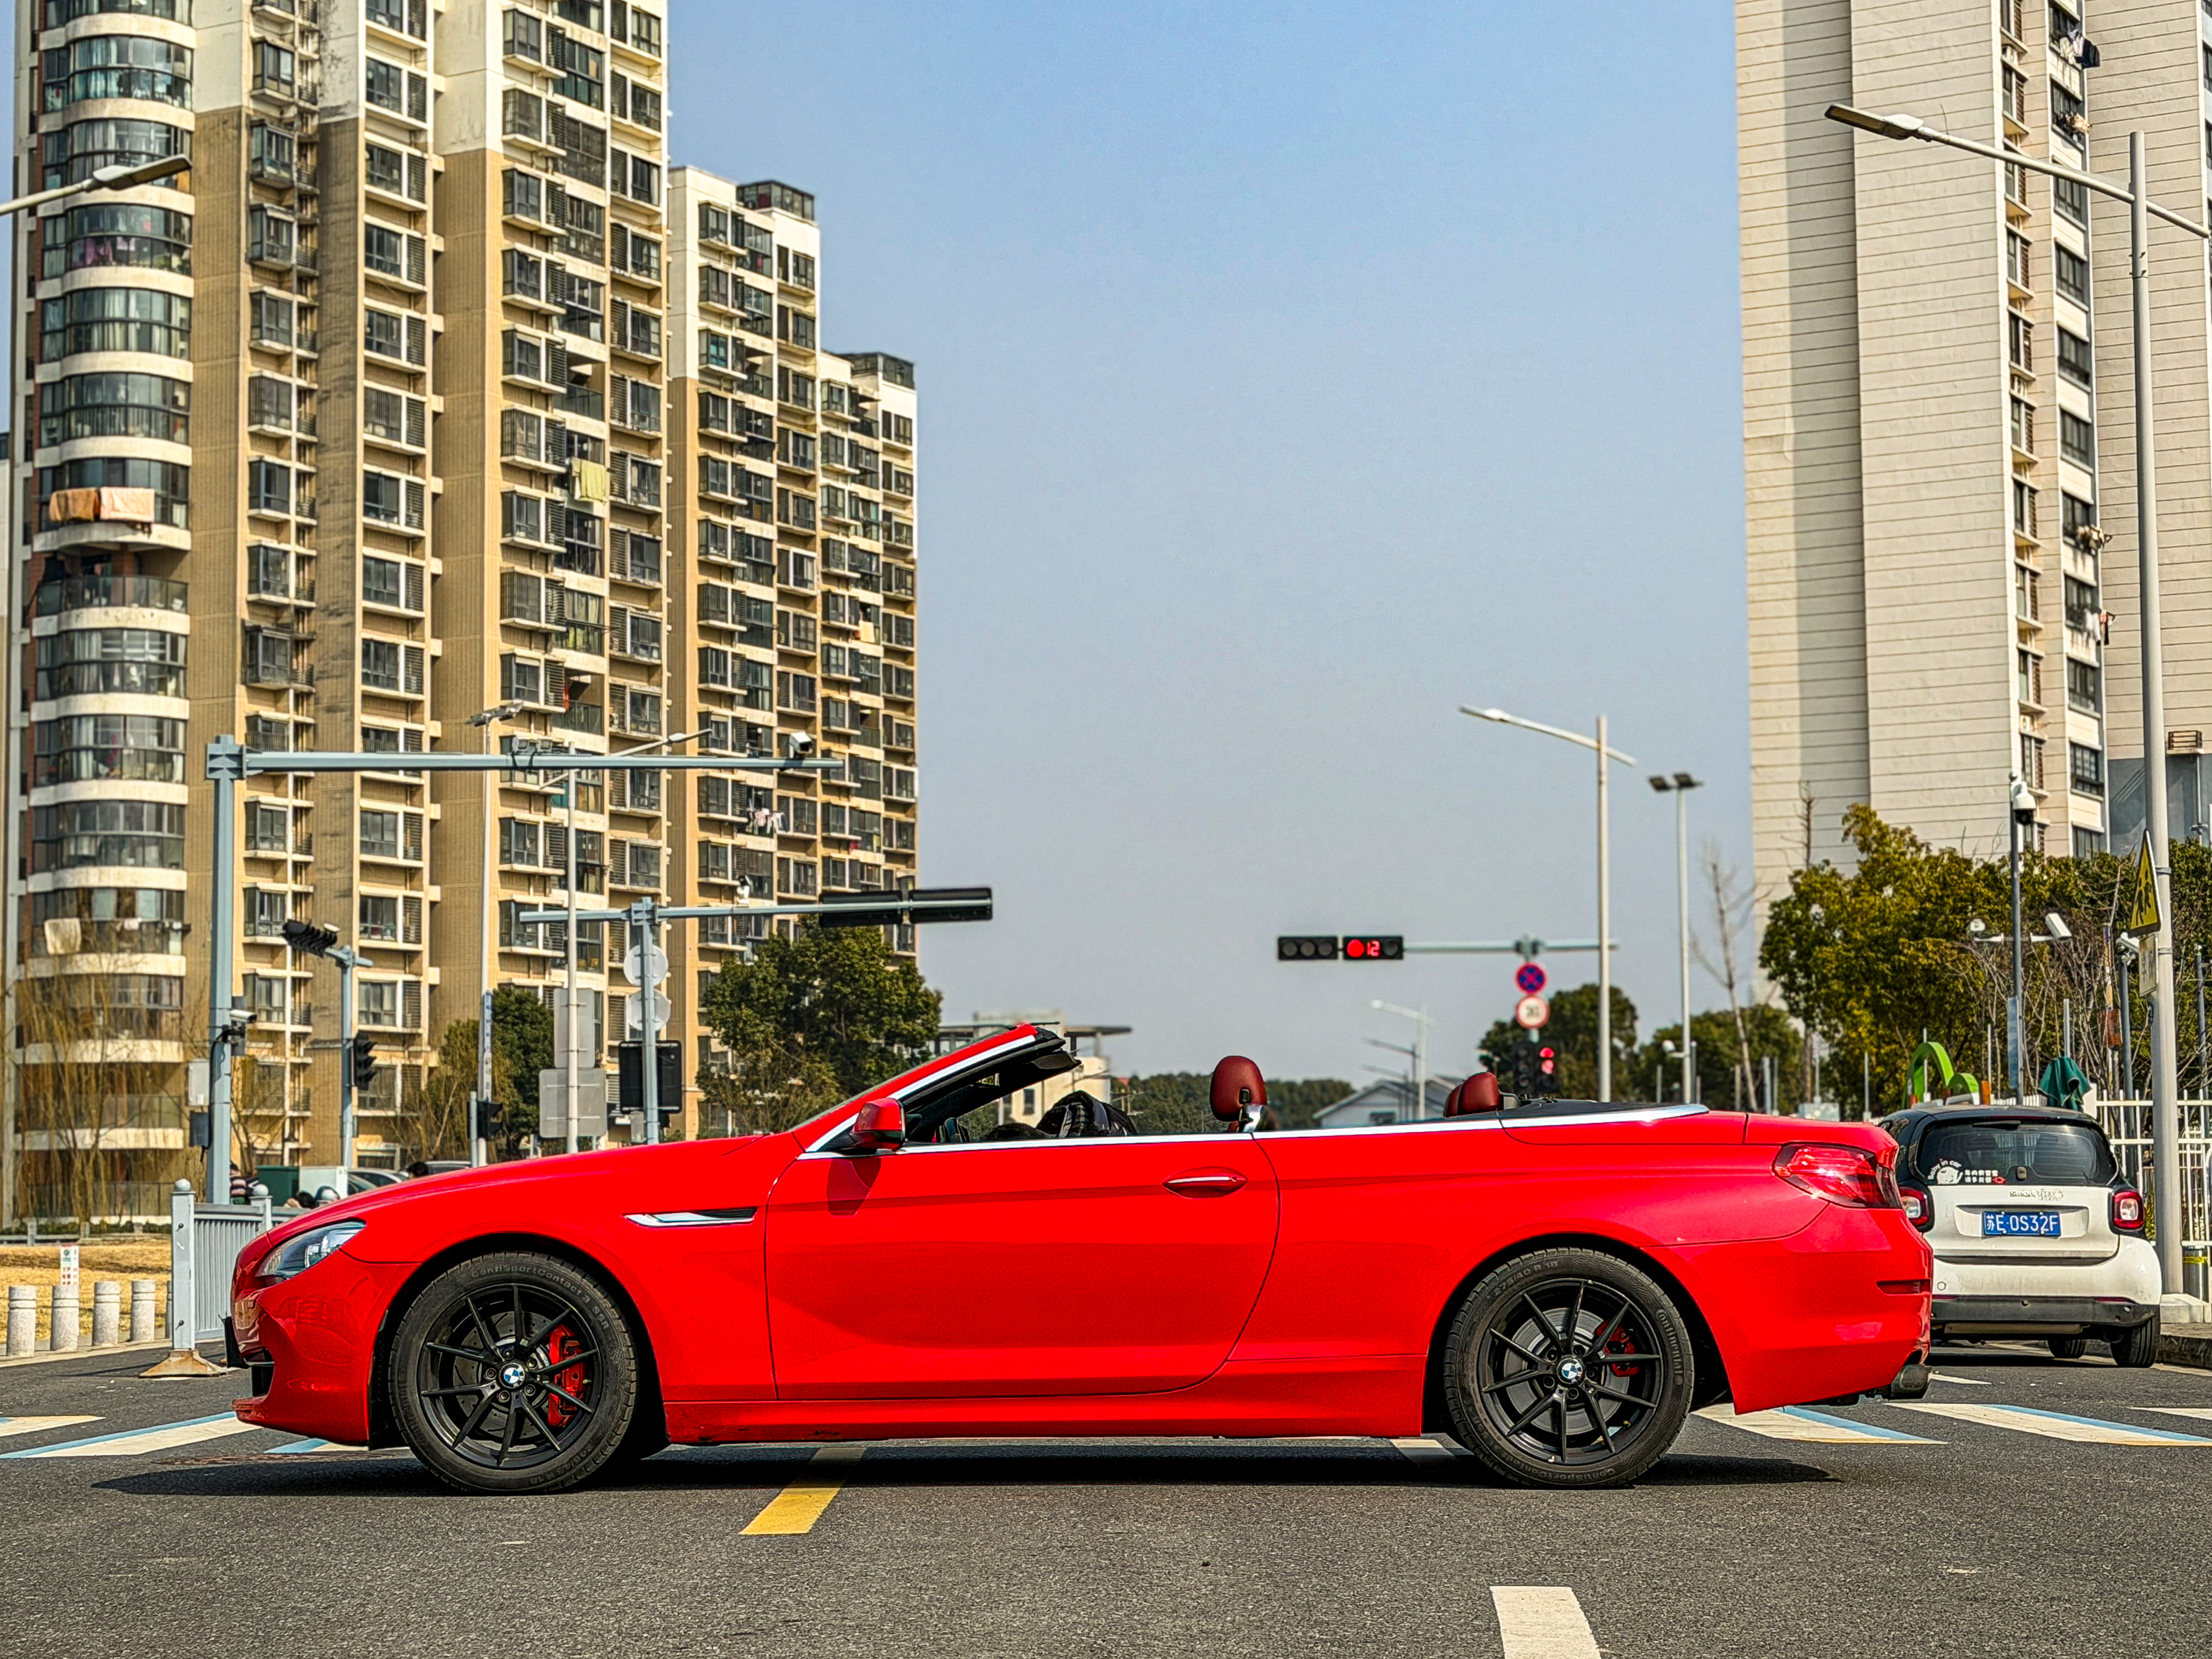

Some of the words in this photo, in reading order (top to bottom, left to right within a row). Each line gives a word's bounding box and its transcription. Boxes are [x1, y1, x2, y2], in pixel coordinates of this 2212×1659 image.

[1367, 940, 1380, 956] 12
[1939, 1158, 1948, 1166] in
[1656, 1309, 1683, 1374] Continental
